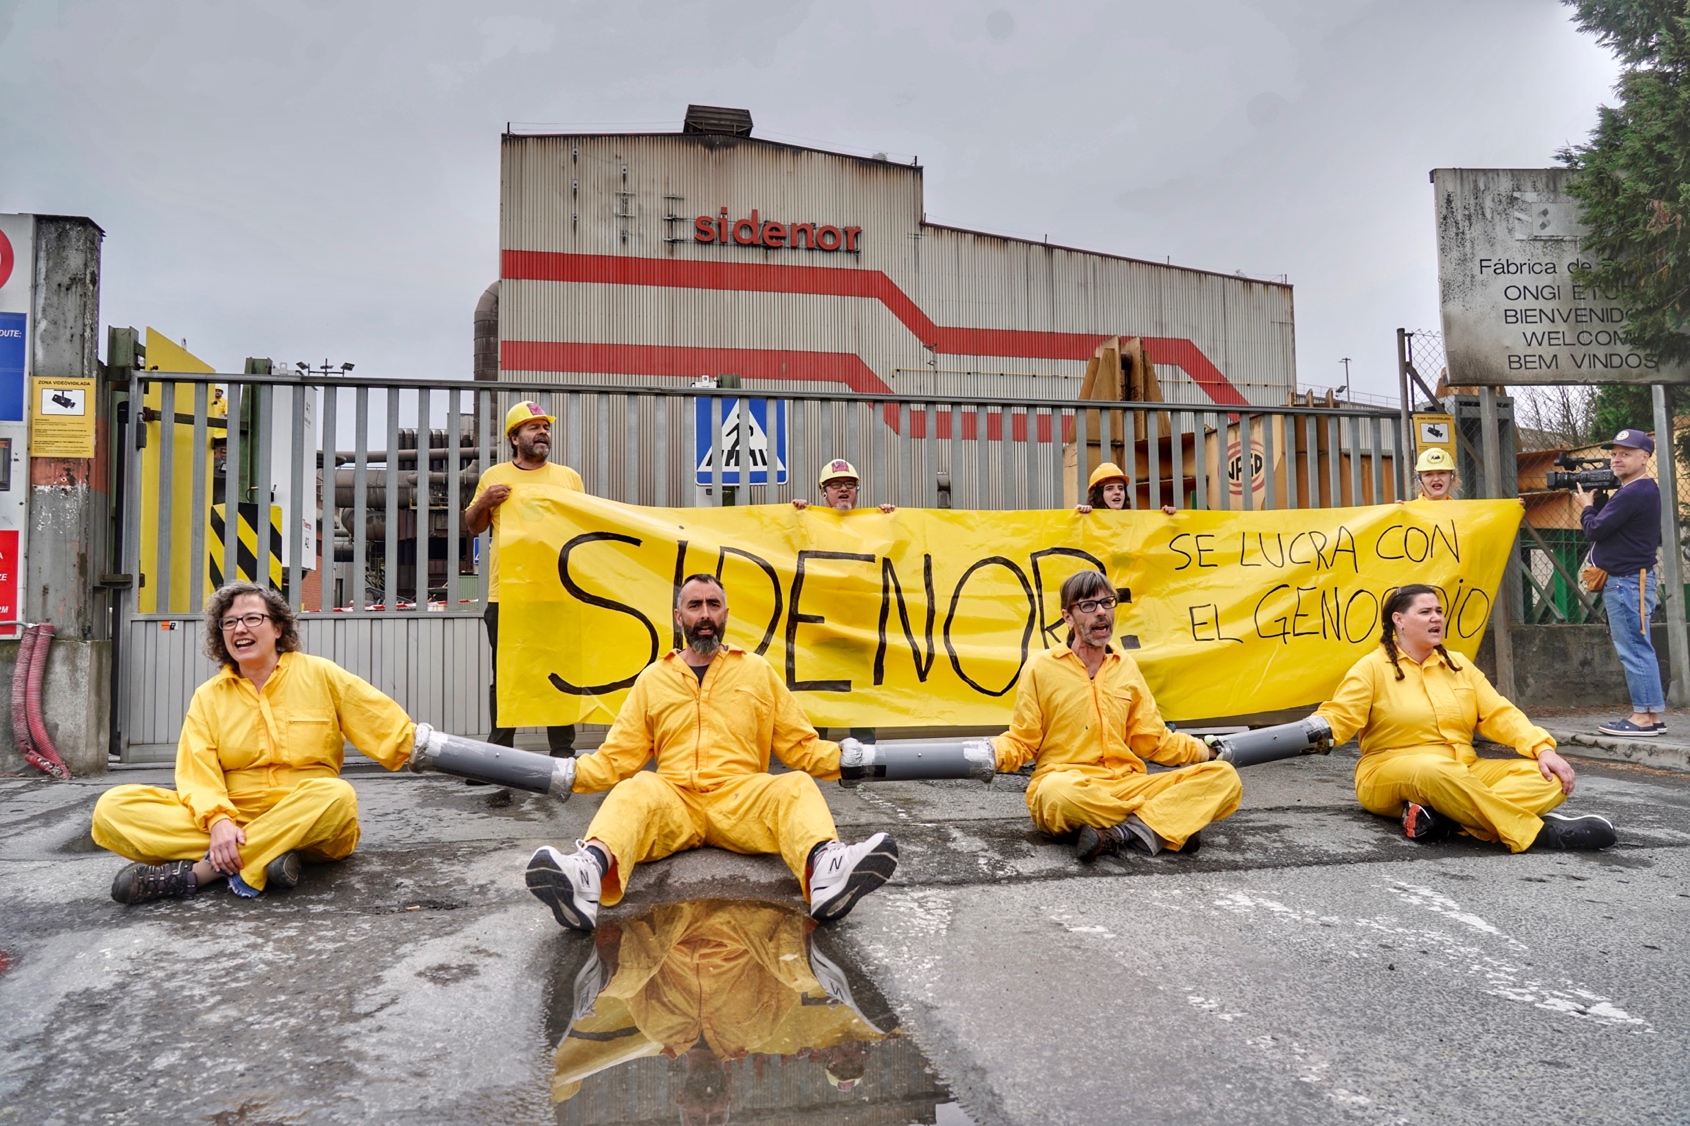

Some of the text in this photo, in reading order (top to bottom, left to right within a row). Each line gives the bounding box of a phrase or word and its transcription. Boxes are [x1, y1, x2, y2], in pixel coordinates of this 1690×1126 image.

[694, 206, 862, 251] sidenor
[1479, 258, 1558, 275] Fábrica
[1504, 284, 1561, 301] ONGI
[1507, 353, 1658, 370] BEM VINDOS
[1168, 519, 1460, 573] SE LUCRA CON
[1188, 604, 1243, 644] EL
